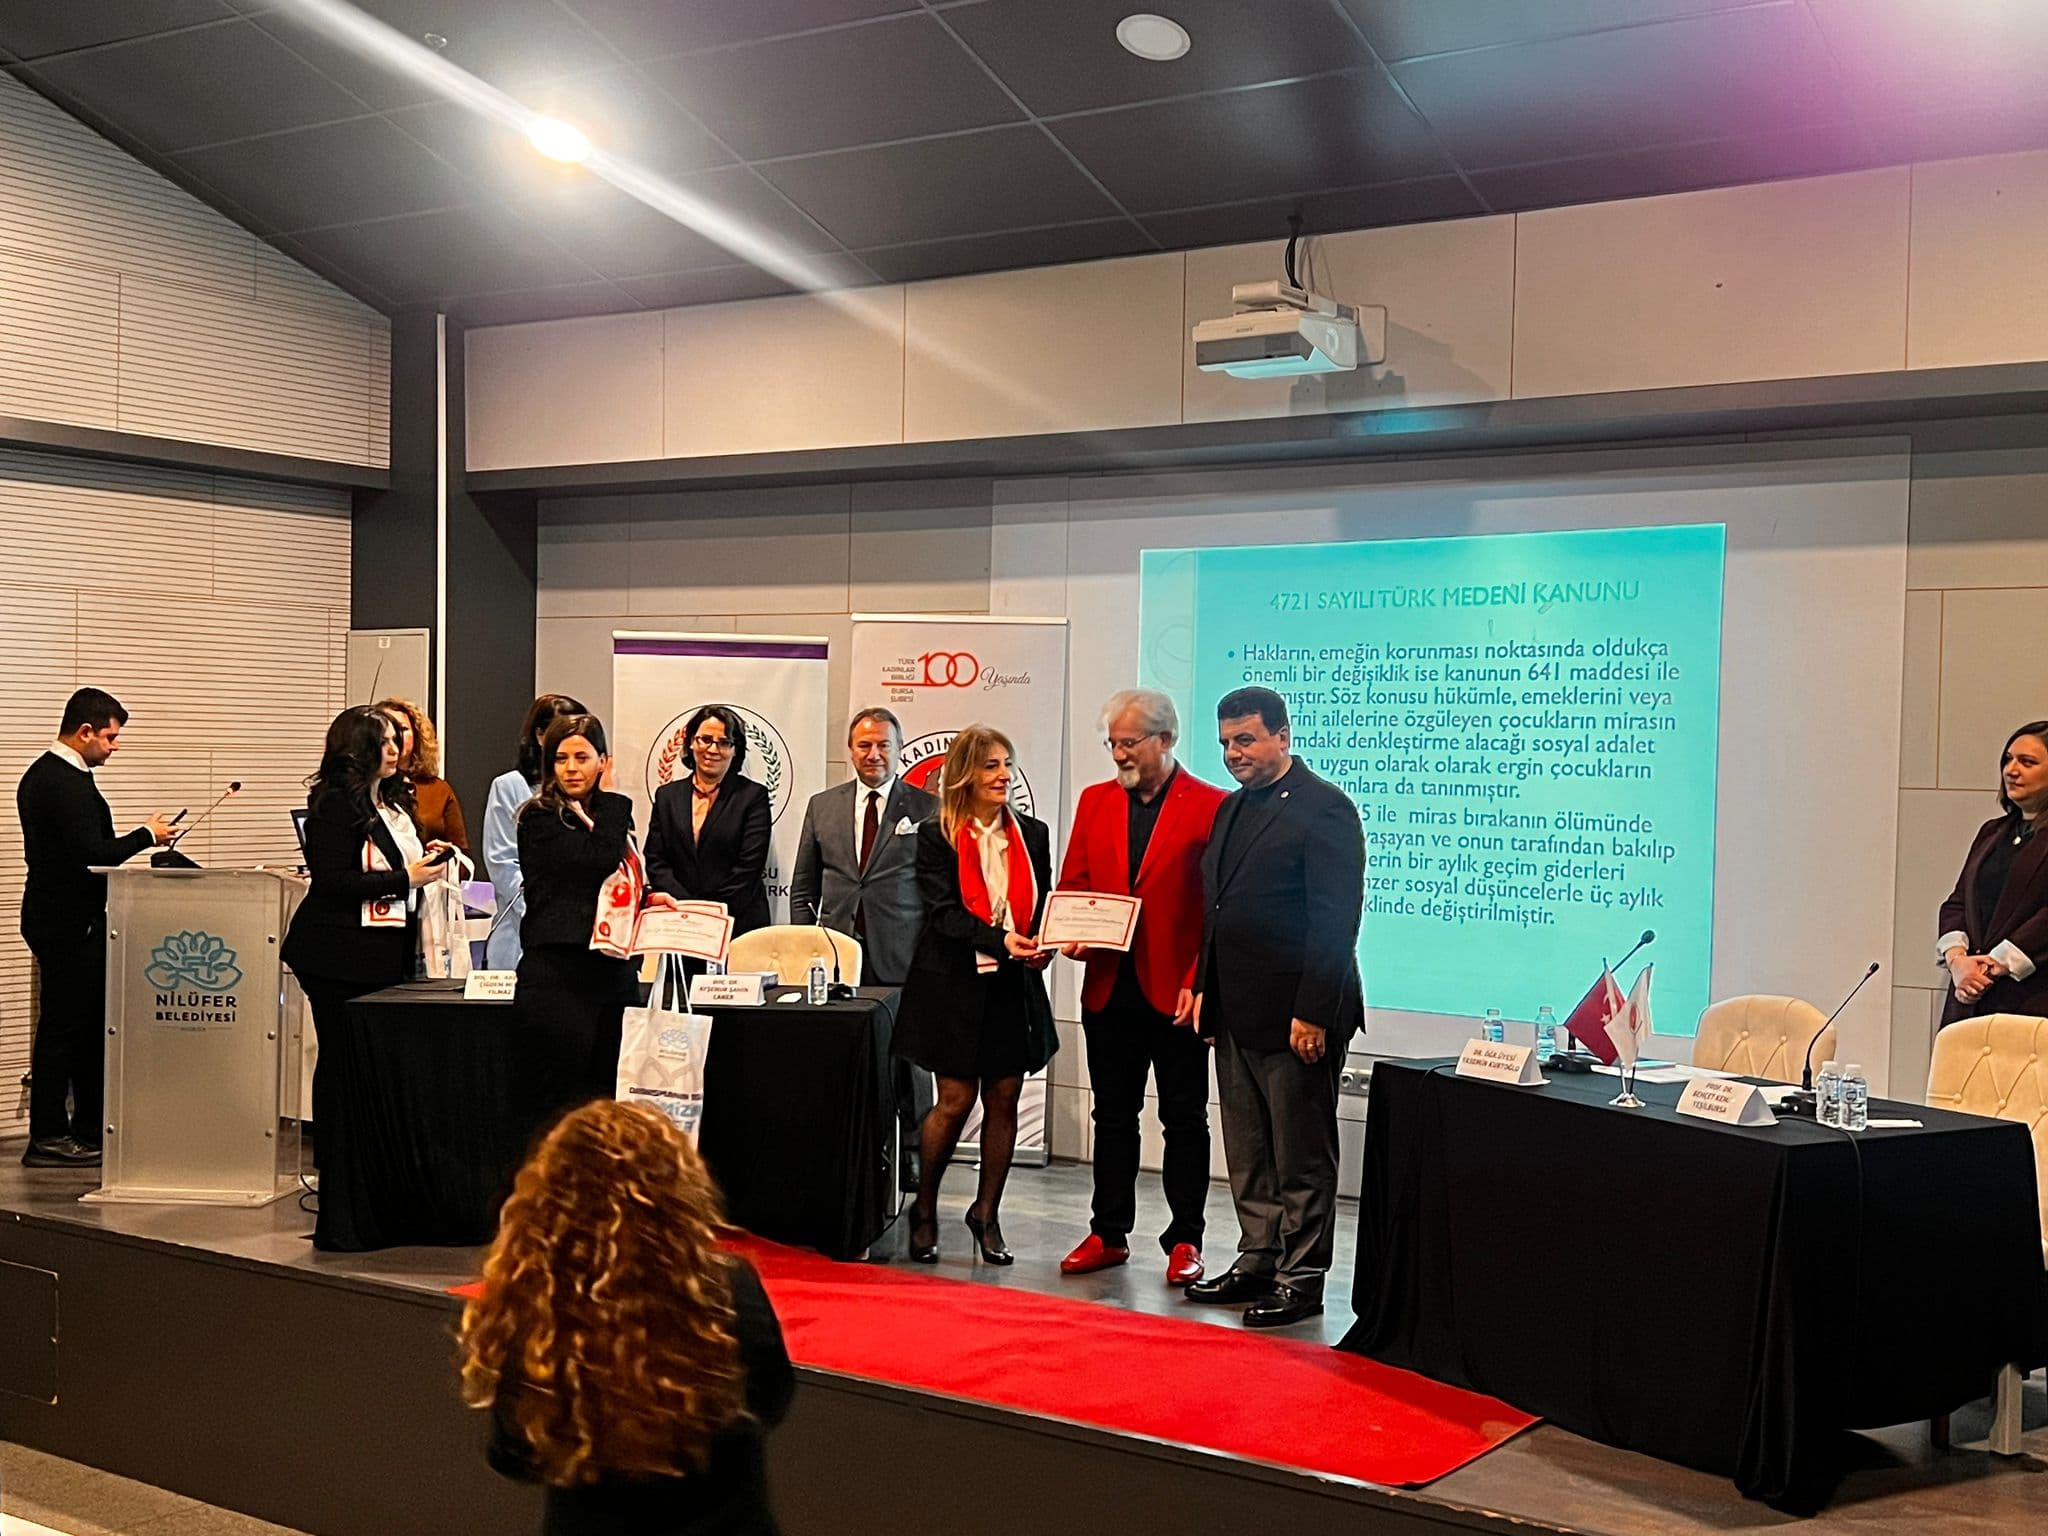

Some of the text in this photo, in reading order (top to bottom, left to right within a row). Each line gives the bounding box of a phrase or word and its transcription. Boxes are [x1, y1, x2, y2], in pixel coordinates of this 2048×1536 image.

[1270, 592, 1309, 611] 4721
[1378, 585, 1436, 608] TÜRK
[1443, 583, 1526, 606] MEDENİ
[1533, 580, 1640, 603] KANUNU
[1243, 637, 1669, 664] Hakların, emeğin korunması noktasında oldukça
[917, 652, 1031, 691] 100 Yaşında
[1242, 661, 1680, 688] önemli bir değişiklik ise kanunun 641 maddesi ile
[1331, 687, 1361, 704] Söz
[1366, 687, 1427, 705] konusu
[1434, 687, 1517, 706] hükümle,
[1521, 686, 1622, 705] emeklerini
[1629, 691, 1673, 711] veya
[1290, 710, 1676, 733] rini ailelerine özgüleyen çocukların mirasın
[900, 737, 953, 767] KADIN
[1292, 731, 1656, 757] mdaki denkleştirme alacağı sosyal adalet
[1320, 757, 1369, 776] uygun
[1375, 755, 1429, 772] olarak
[1435, 755, 1492, 774] olarak
[1497, 758, 1543, 780] ergin
[1550, 758, 1652, 780] çocukların
[1395, 776, 1415, 794] da
[1421, 781, 1521, 803] tanınmıştır.
[1377, 804, 1397, 822] ile
[1409, 807, 1457, 824] miras
[1464, 807, 1547, 829] bırakanın
[1554, 811, 1653, 833] ölümünde
[1431, 834, 1452, 847] ve
[1457, 836, 1504, 850] onun
[1511, 834, 1605, 855] tarafından
[1612, 837, 1676, 864] bakılıp
[1368, 851, 1625, 882] erin bir aylık geçim giderleri
[1405, 876, 1458, 899] sosyal
[1464, 877, 1584, 902] düşüncelerle
[1590, 885, 1613, 908] üç
[1619, 887, 1664, 911] aylık
[1363, 895, 1556, 929] klinde değiştirilmiştir.
[156, 990, 237, 1008] NİLÜFER
[156, 1010, 236, 1022] BELEDİYESİ
